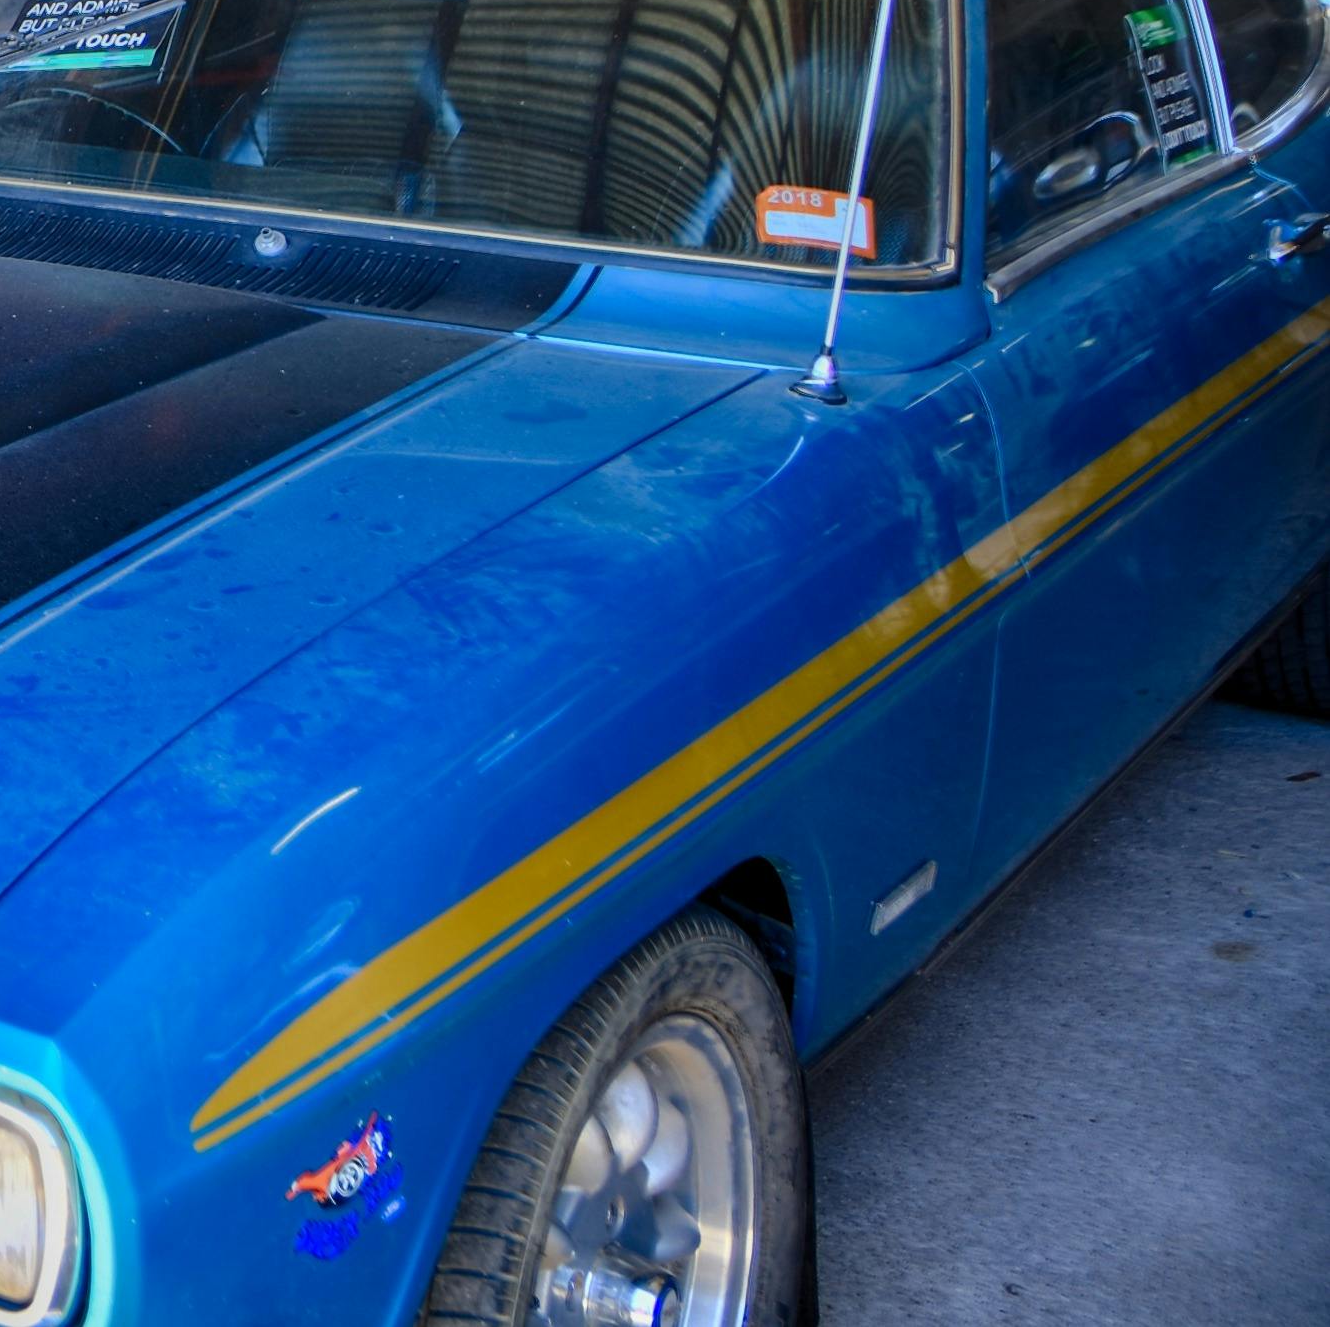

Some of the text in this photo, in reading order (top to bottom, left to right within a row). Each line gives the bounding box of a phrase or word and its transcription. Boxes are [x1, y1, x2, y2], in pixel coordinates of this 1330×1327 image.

[26, 1, 69, 18] AND
[18, 17, 59, 34] BUT
[76, 31, 147, 50] TOUCH
[768, 189, 823, 209] 2018
